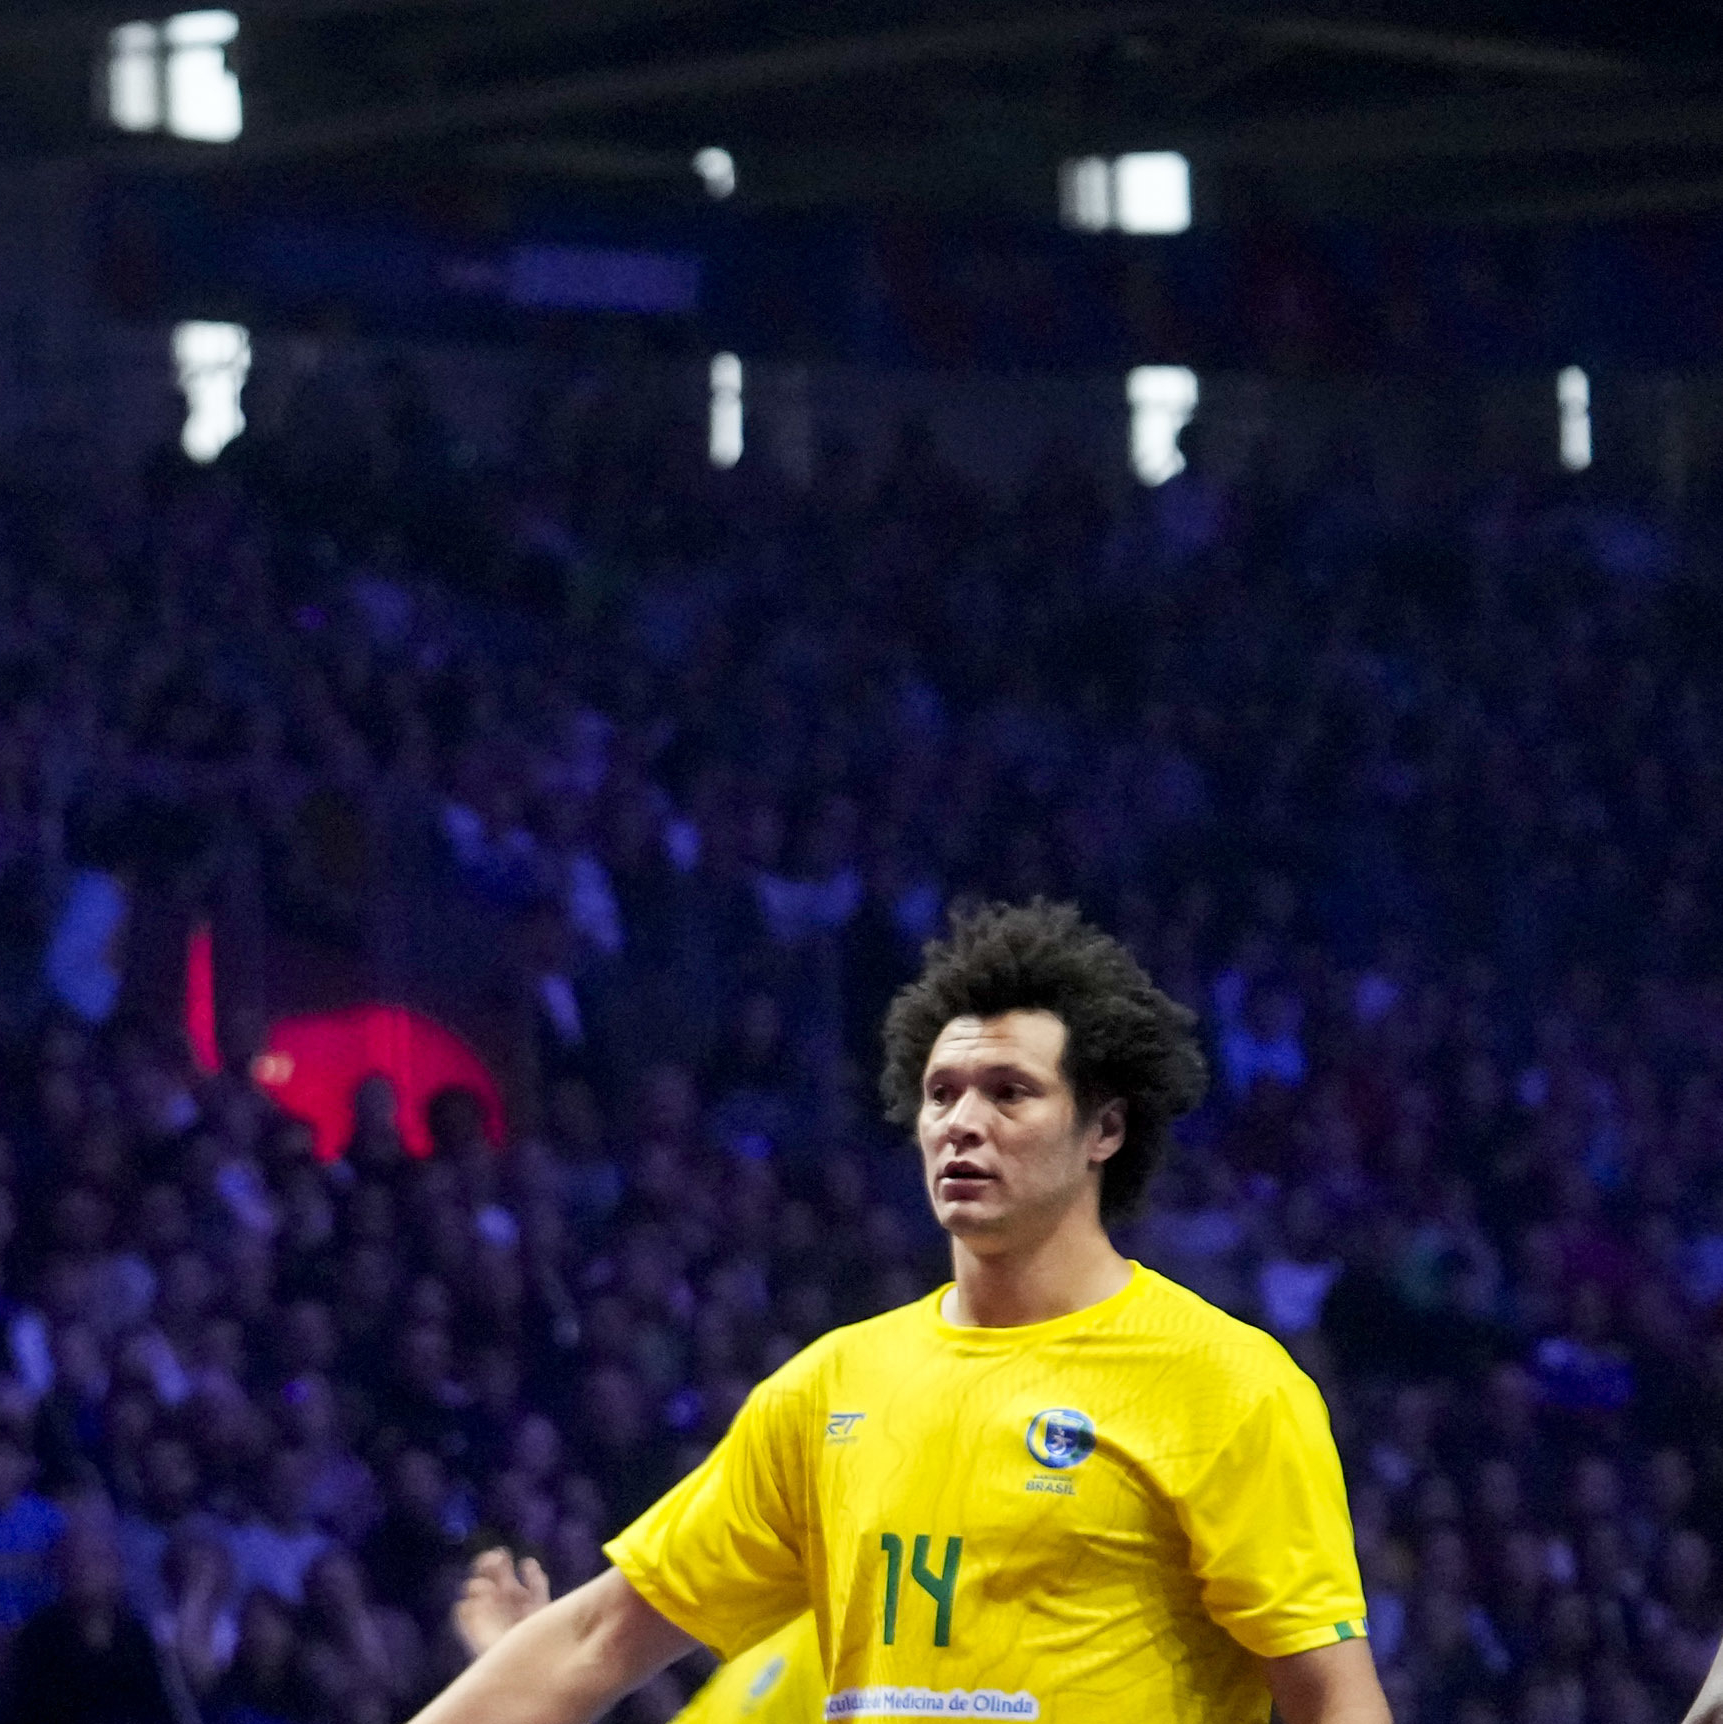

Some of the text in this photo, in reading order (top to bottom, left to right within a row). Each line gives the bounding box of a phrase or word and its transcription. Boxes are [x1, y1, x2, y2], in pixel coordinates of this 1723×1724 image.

[881, 1532, 963, 1648] 14
[948, 1695, 969, 1711] de
[973, 1694, 1033, 1714] Olinda
